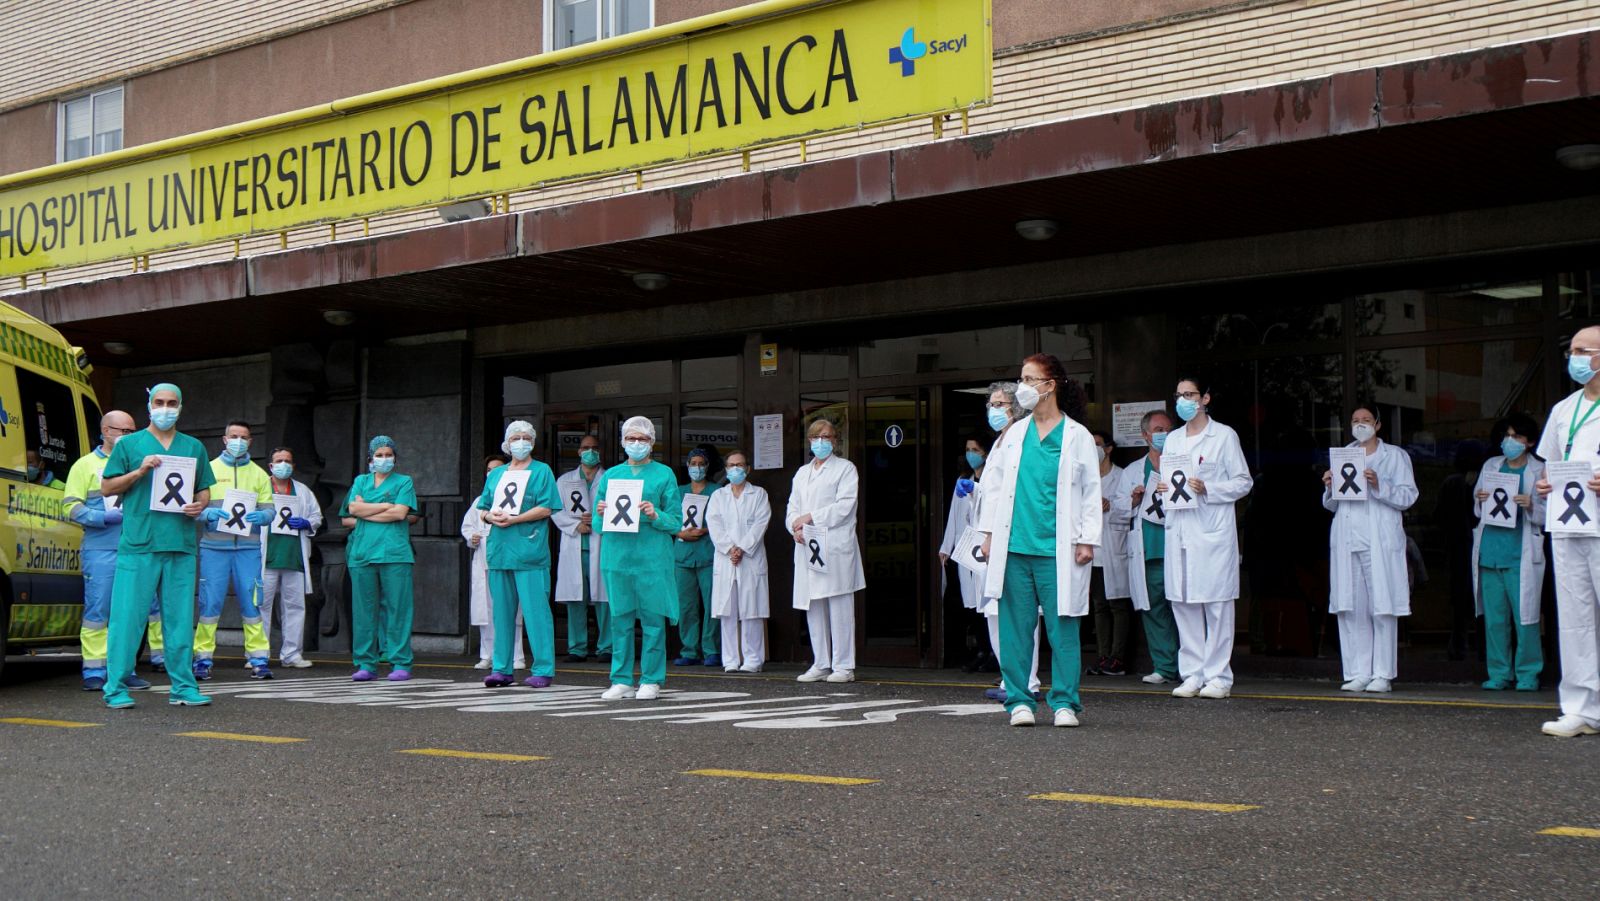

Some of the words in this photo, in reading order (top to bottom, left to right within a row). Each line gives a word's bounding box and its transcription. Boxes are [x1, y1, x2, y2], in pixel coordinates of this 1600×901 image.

[929, 33, 967, 55] Sacyl
[0, 181, 137, 259] HOSPITAL
[147, 119, 433, 233] UNIVERSITARIO
[450, 104, 502, 179] DE
[520, 28, 859, 165] SALAMANCA
[27, 538, 80, 571] Sanitarias
